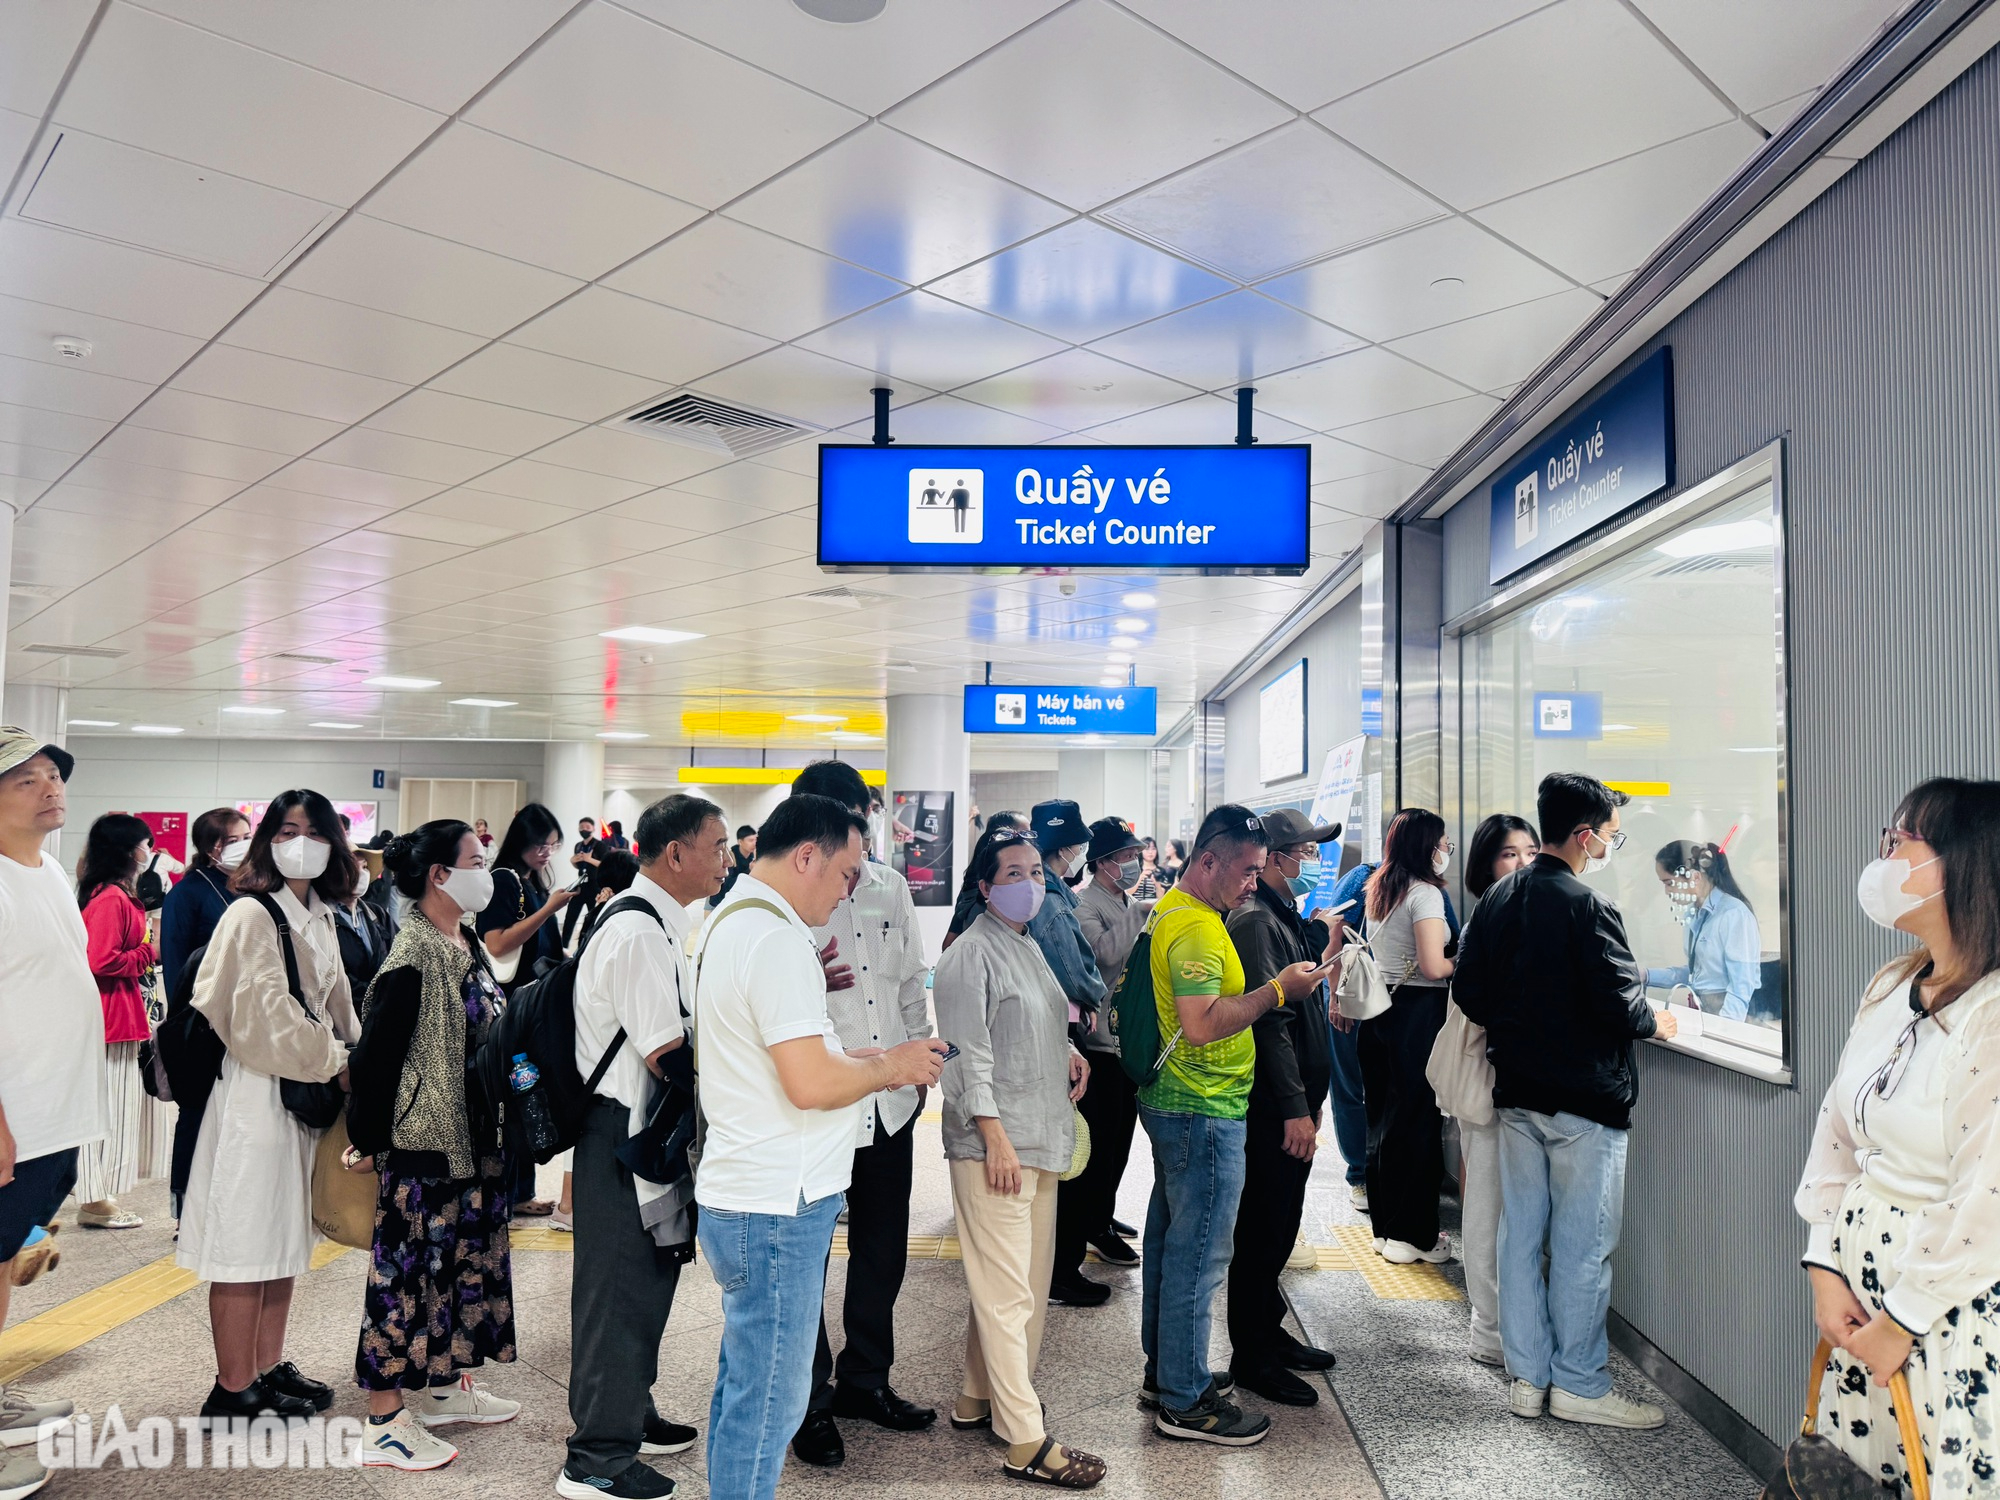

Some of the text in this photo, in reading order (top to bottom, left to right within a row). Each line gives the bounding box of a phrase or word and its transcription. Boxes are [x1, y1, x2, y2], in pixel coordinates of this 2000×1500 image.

[1547, 420, 1604, 491] Quầy vé
[1015, 464, 1171, 514] Quầy vé
[1548, 466, 1623, 529] Ticket Counter
[1014, 518, 1216, 545] Ticket Counter
[1037, 694, 1125, 713] Máy bán vé
[1037, 713, 1077, 726] Tickets
